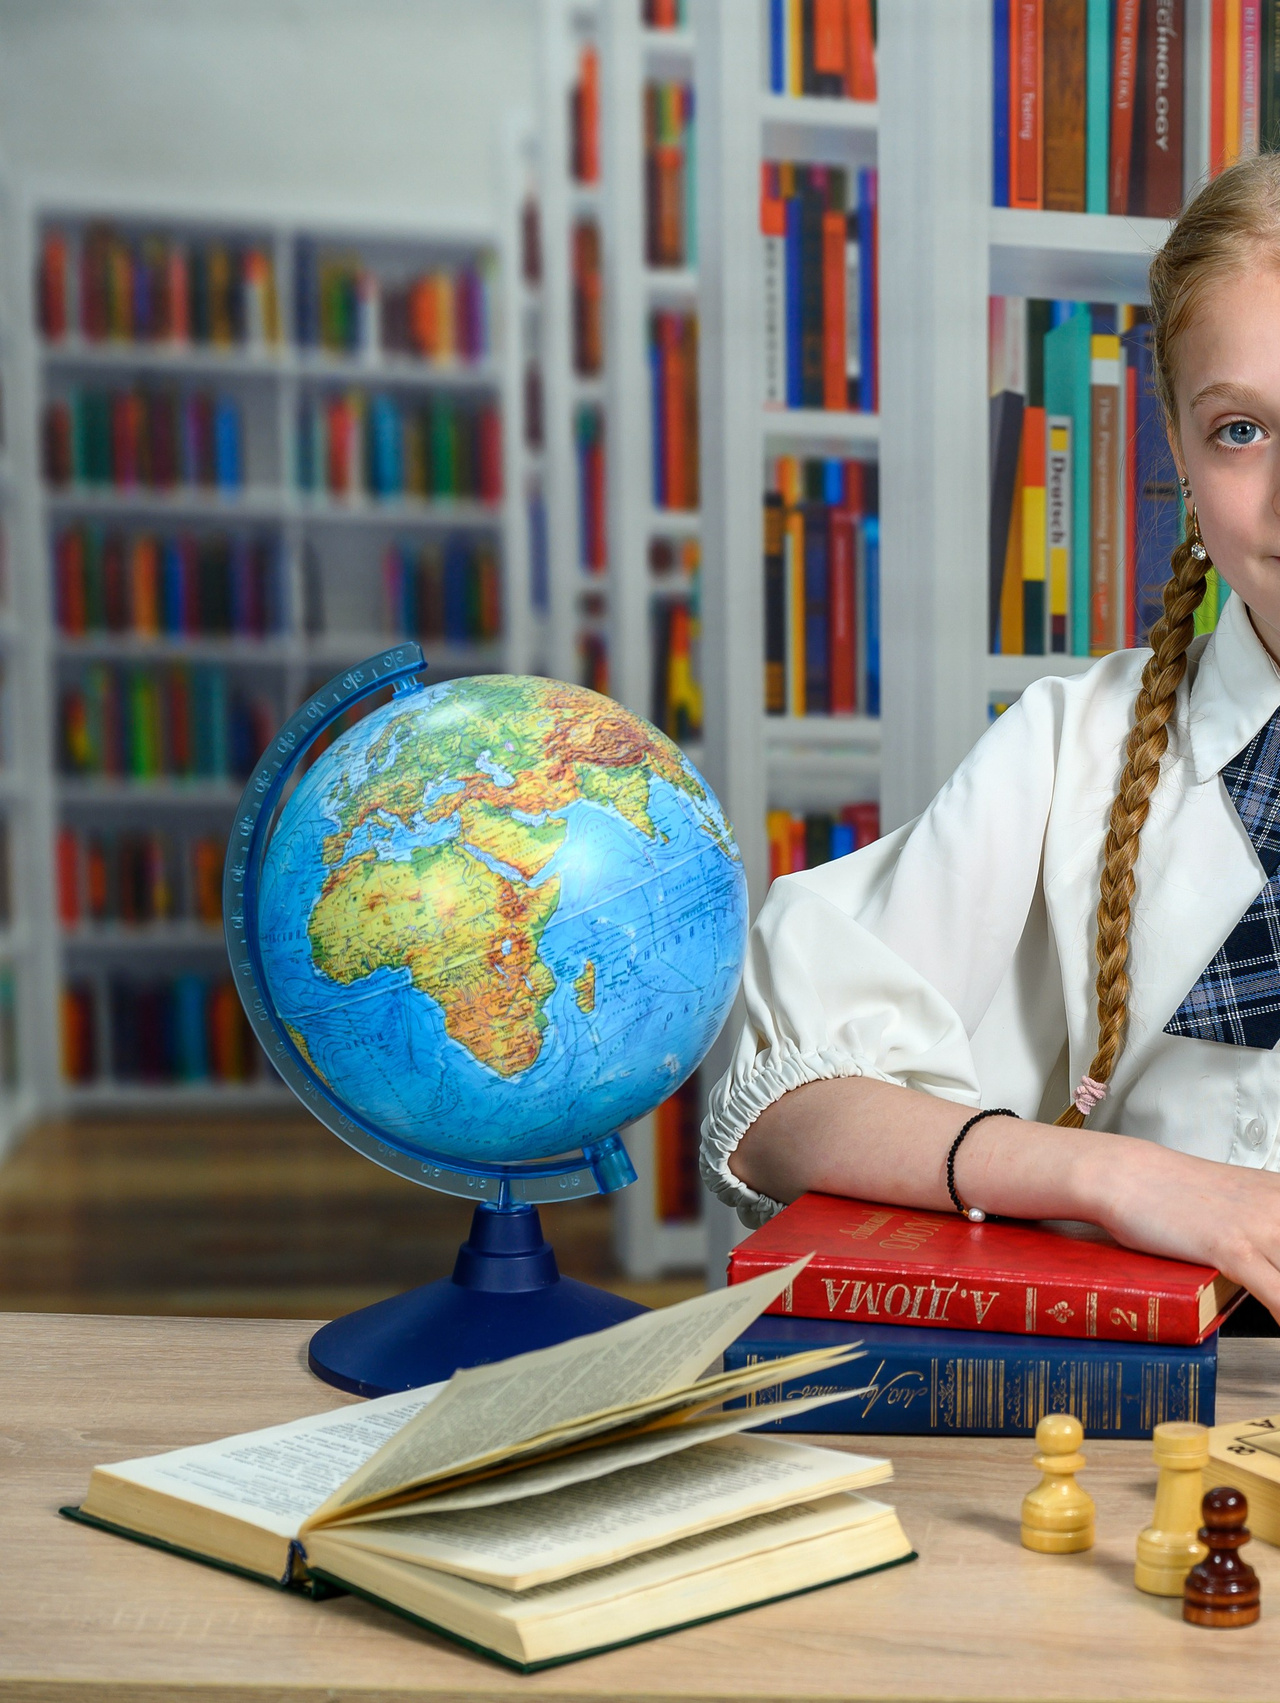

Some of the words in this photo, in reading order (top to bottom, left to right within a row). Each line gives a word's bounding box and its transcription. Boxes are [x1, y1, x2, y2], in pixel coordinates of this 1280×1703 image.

[1051, 456, 1066, 544] Deutsch
[820, 1277, 958, 1322] ДЮМА
[960, 1286, 1001, 1325] А.
[1226, 1445, 1257, 1456] 8
